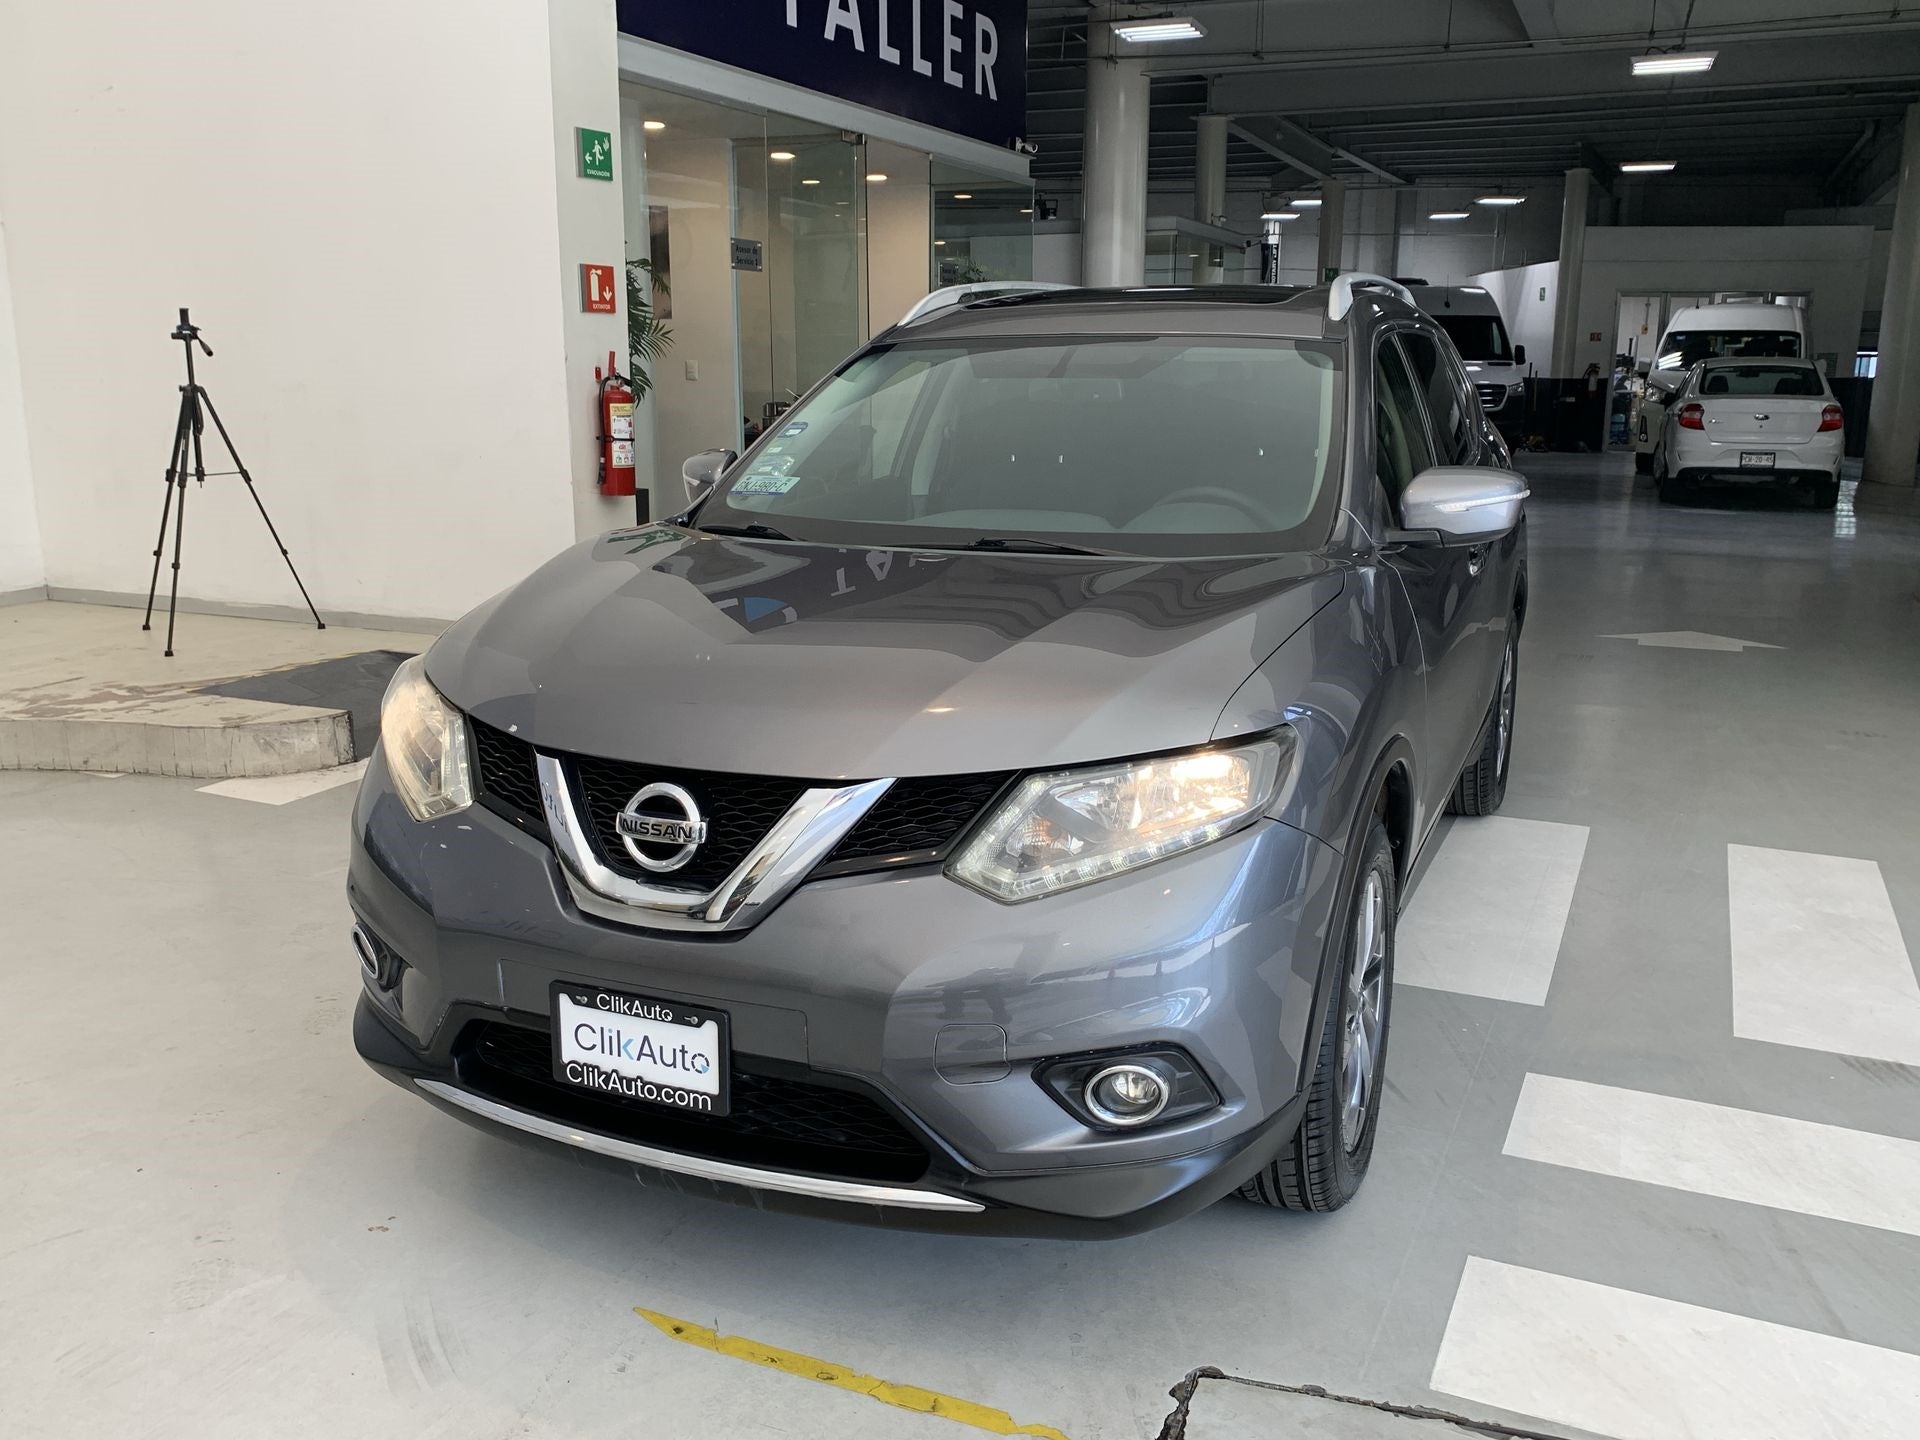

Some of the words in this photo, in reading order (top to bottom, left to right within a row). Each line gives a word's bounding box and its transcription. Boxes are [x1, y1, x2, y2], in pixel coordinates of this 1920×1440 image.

[621, 818, 693, 839] NISSAN
[596, 993, 673, 1023] ClikAuto
[574, 1022, 710, 1074] ClikAuto
[566, 1062, 712, 1112] ClikAuto.com
